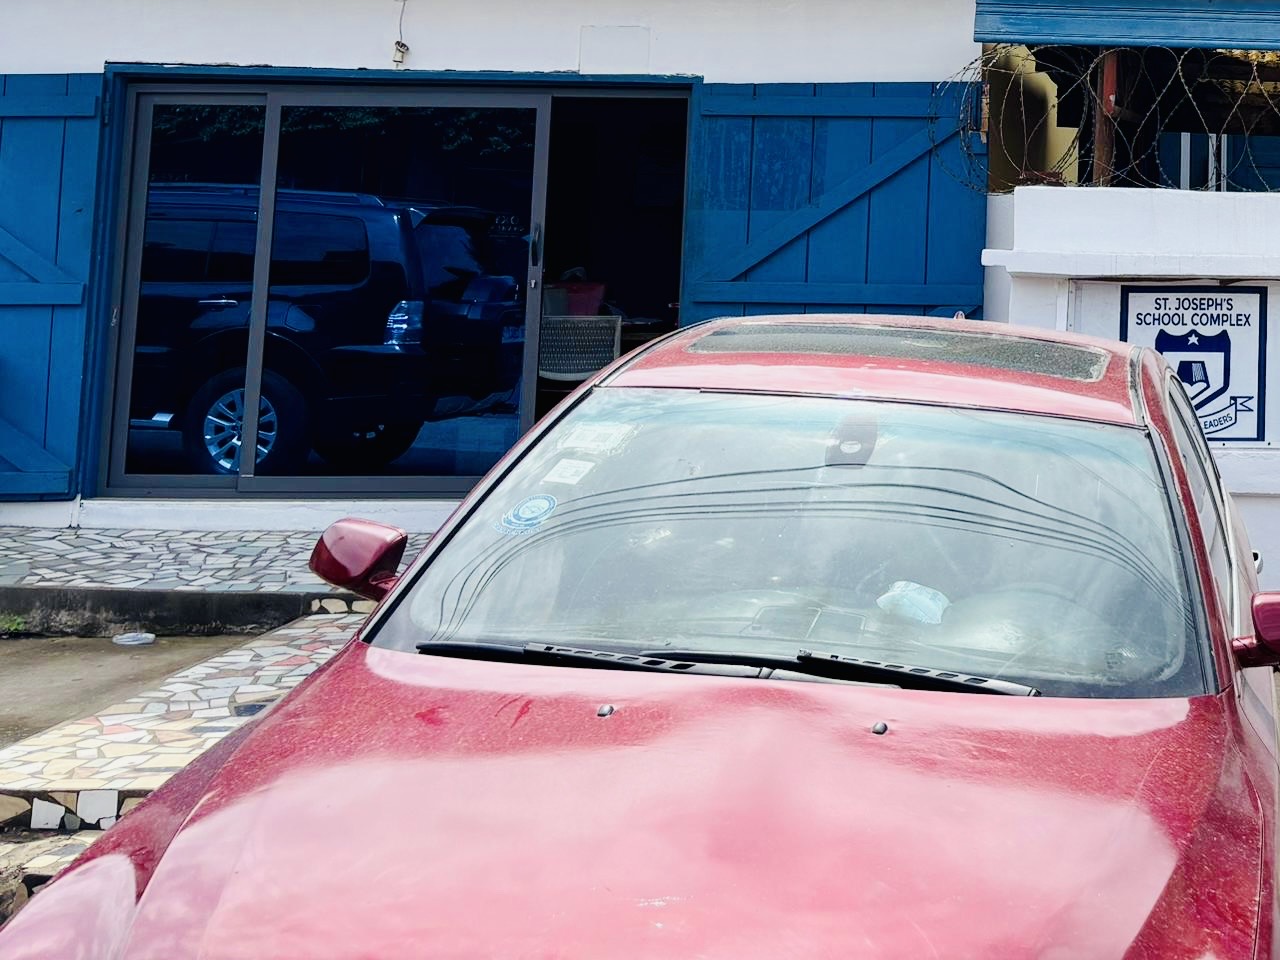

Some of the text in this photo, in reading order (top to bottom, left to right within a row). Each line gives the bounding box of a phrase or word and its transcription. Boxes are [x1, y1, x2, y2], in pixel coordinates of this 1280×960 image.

[1154, 297, 1233, 311] ST. JOSEPH'S
[1135, 312, 1251, 327] SCHOOL COMPLEX
[1202, 413, 1233, 430] EADERS
